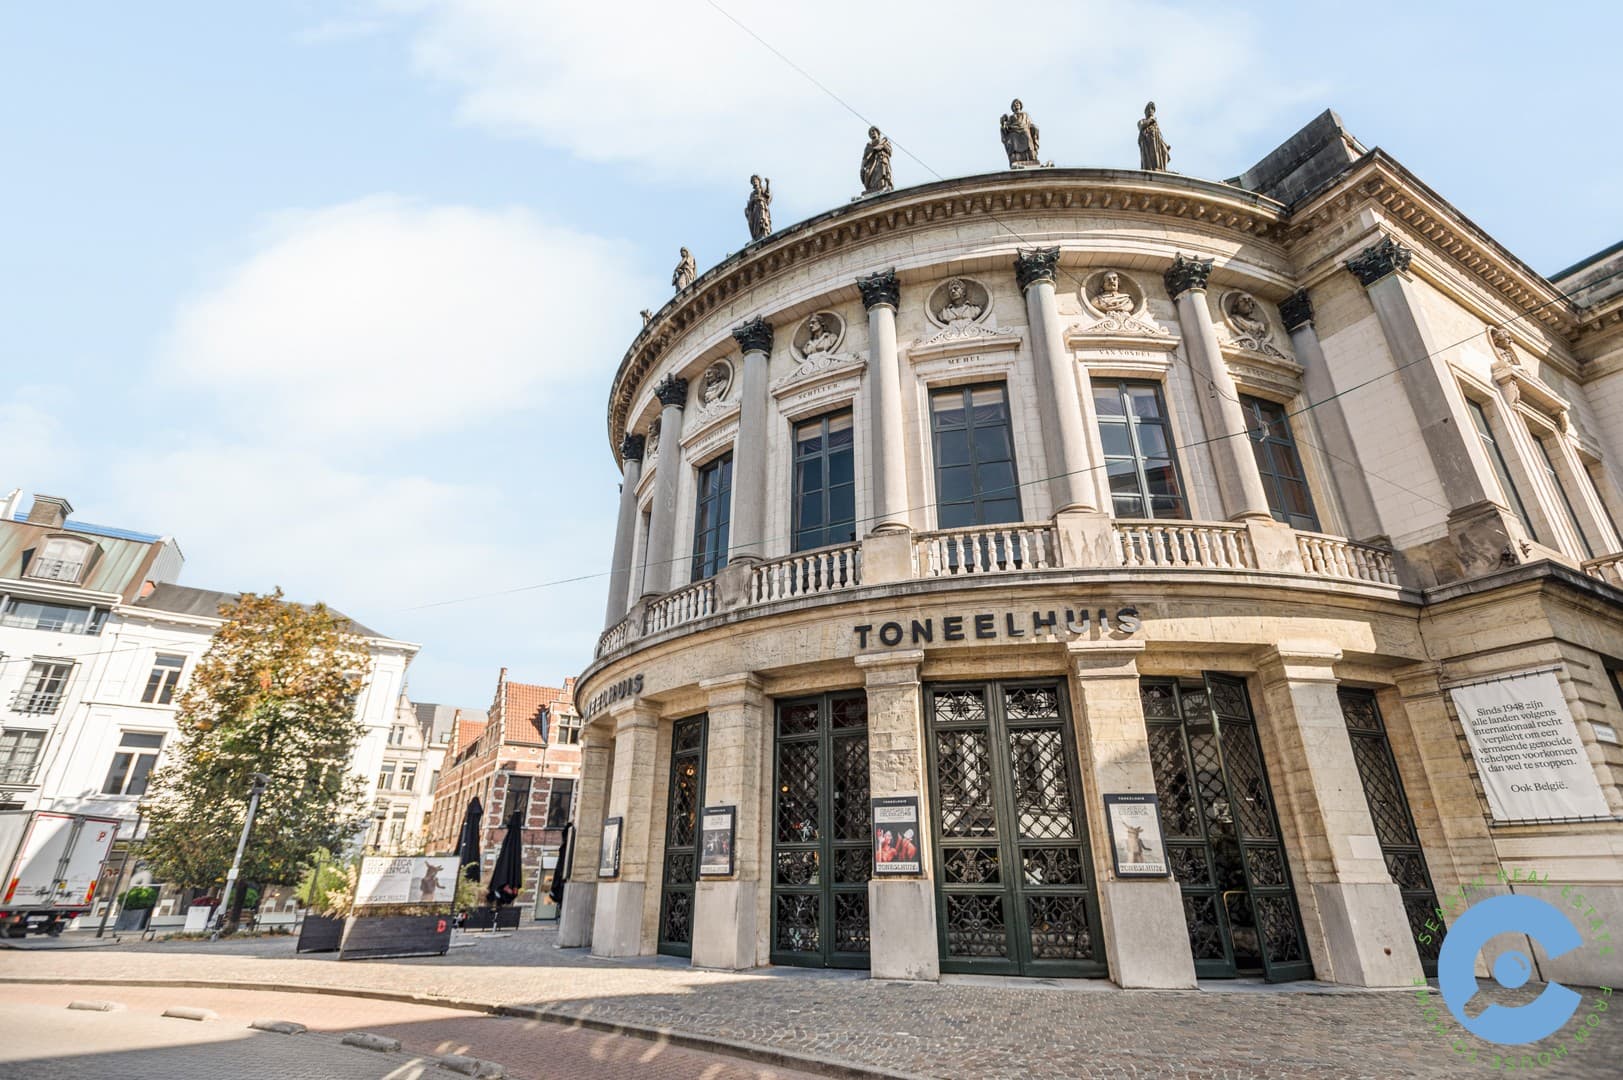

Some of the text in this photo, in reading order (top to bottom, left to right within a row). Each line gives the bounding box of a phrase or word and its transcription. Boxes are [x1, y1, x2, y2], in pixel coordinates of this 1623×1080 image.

[853, 606, 1142, 649] TONEELHUIS
[1476, 700, 1544, 717] Sinds 1948 zijn
[1471, 709, 1557, 726] alle landen volgens
[1536, 717, 1564, 728] recht
[1482, 729, 1559, 744] verplicht om een
[1478, 736, 1573, 754] vermeende genocide
[1522, 747, 1578, 760] voorkomen
[1487, 758, 1577, 773] dan wel te stoppen.
[1510, 783, 1533, 793] Ook
